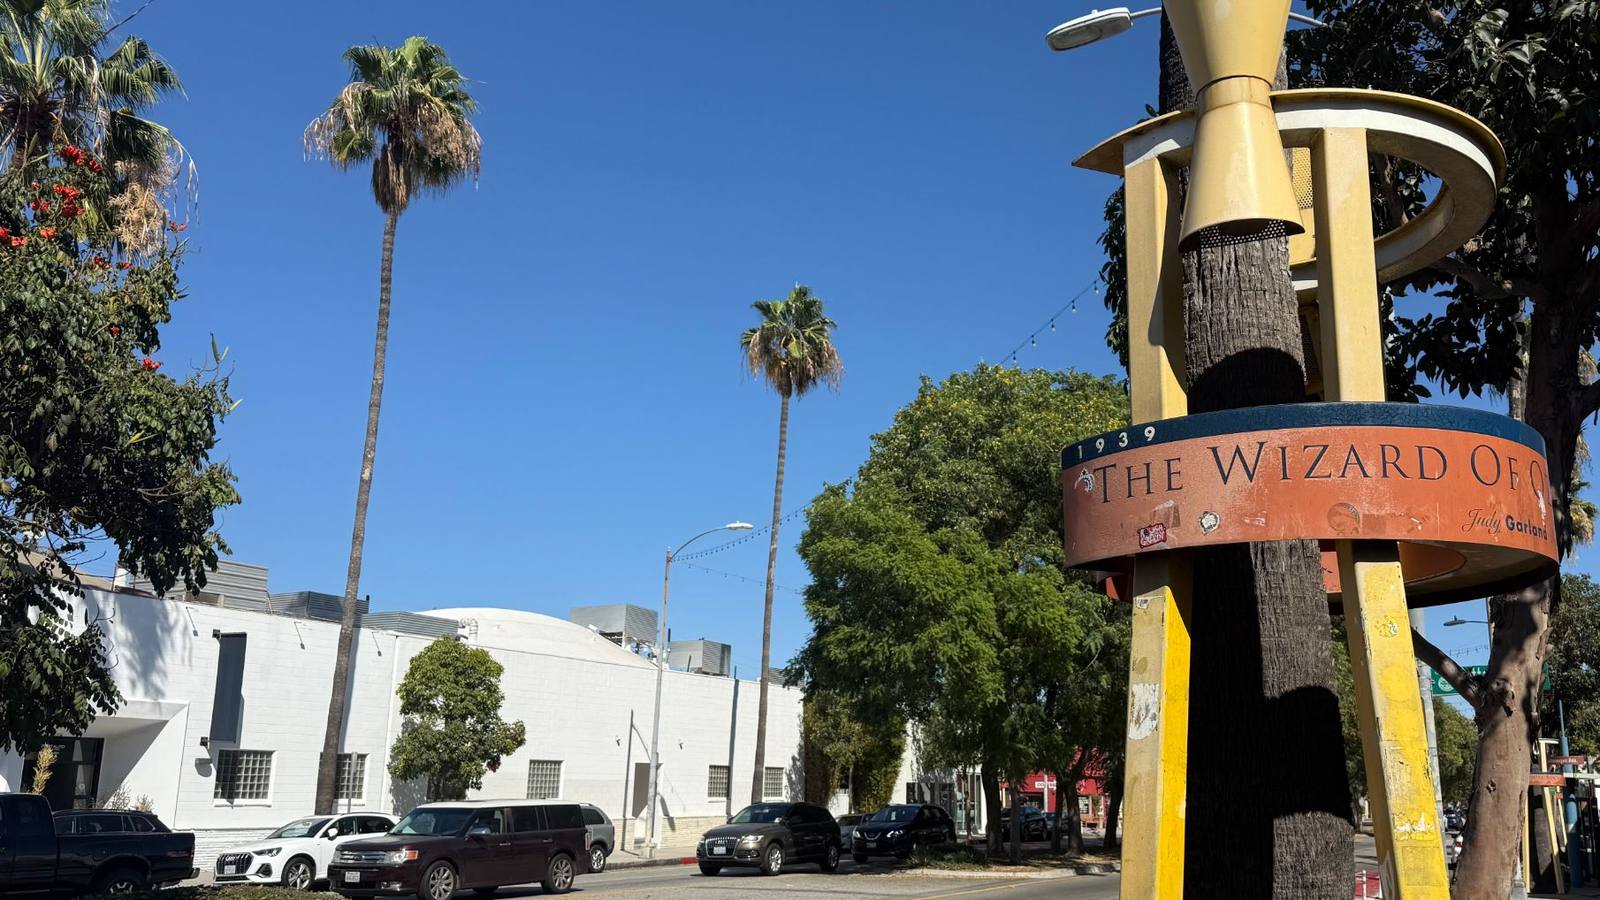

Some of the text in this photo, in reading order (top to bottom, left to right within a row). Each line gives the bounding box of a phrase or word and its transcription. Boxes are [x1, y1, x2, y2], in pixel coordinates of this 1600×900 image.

[1077, 426, 1157, 459] 1939
[1093, 457, 1184, 503] THE
[1207, 441, 1448, 486] WIZARD
[1471, 445, 1520, 491] OF
[1462, 508, 1548, 541] Judy Garland
